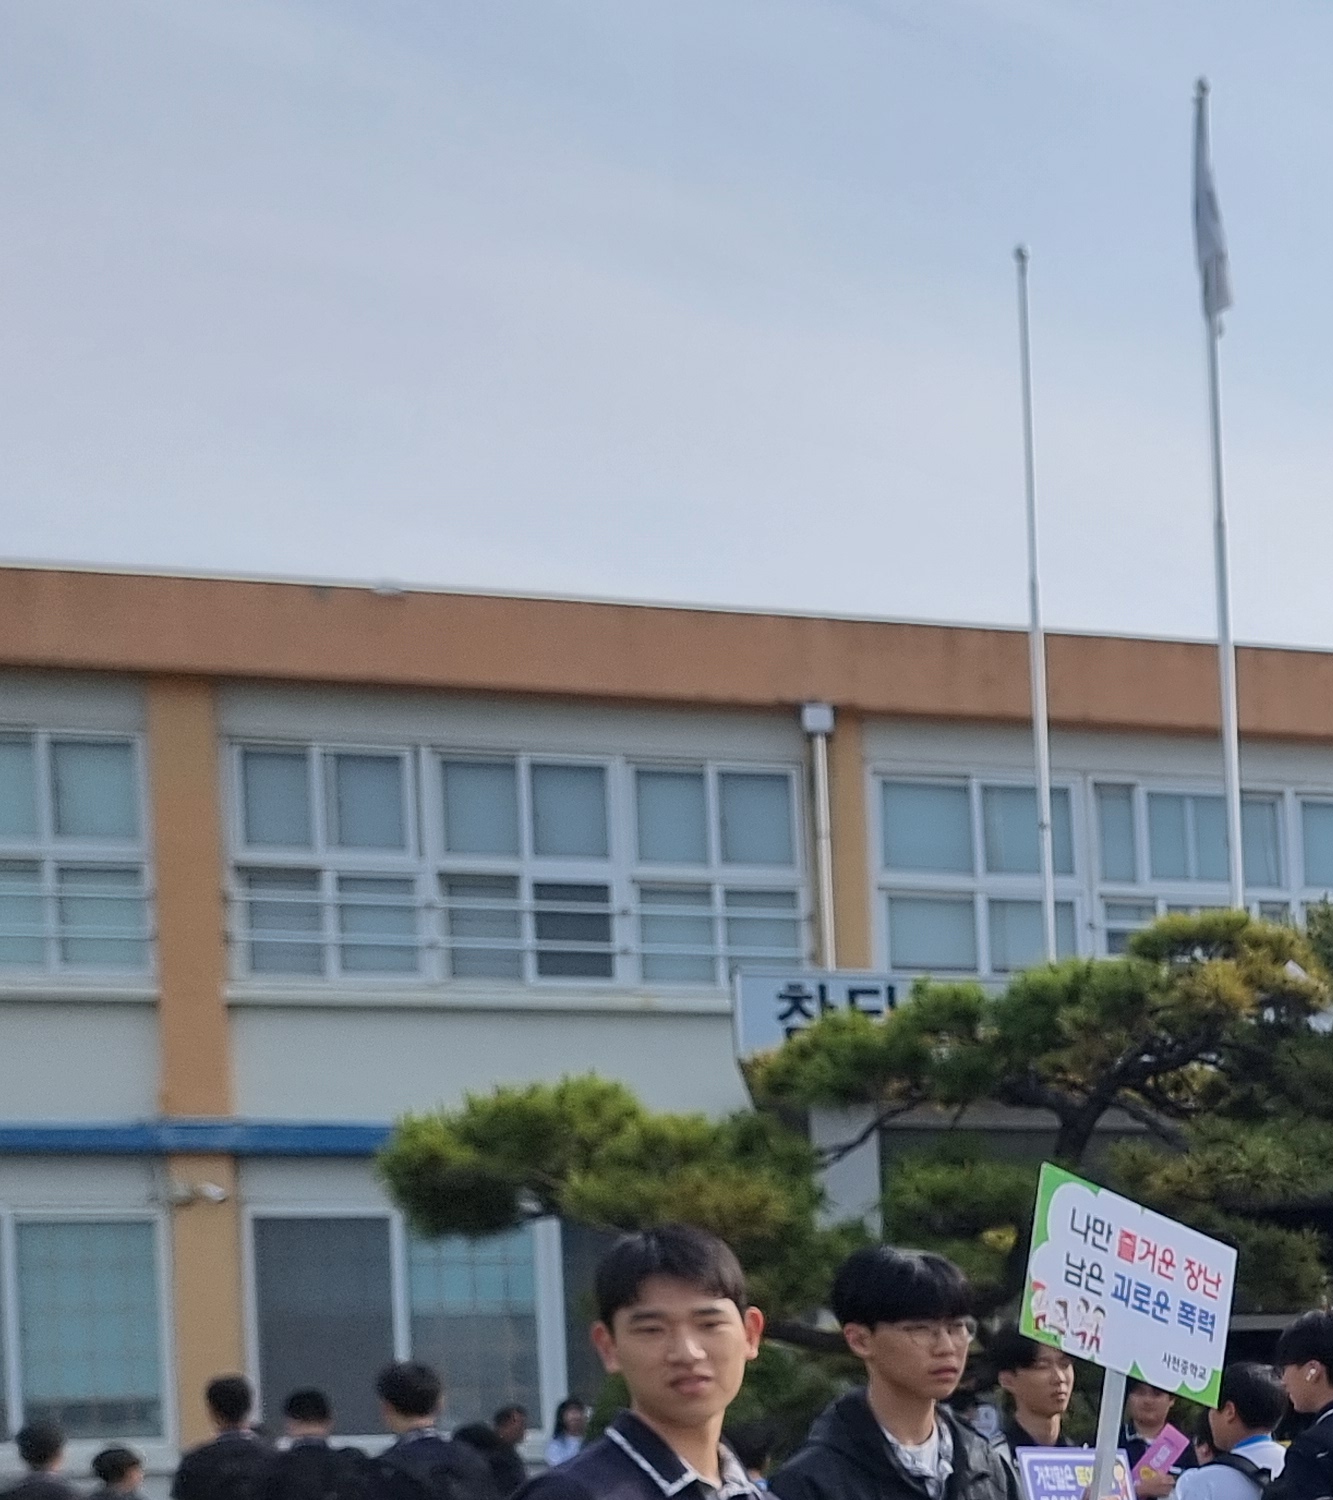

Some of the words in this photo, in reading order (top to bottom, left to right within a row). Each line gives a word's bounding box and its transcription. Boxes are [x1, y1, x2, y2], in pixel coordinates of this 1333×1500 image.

[1064, 1252, 1105, 1297] 남은
[1111, 1271, 1173, 1325] 괴로운
[1176, 1299, 1216, 1342] 폭력
[1070, 1207, 1113, 1252] 나만
[1116, 1228, 1177, 1281] 즐거운
[1183, 1257, 1222, 1300] 장난
[1161, 1351, 1208, 1381] 사천중학교
